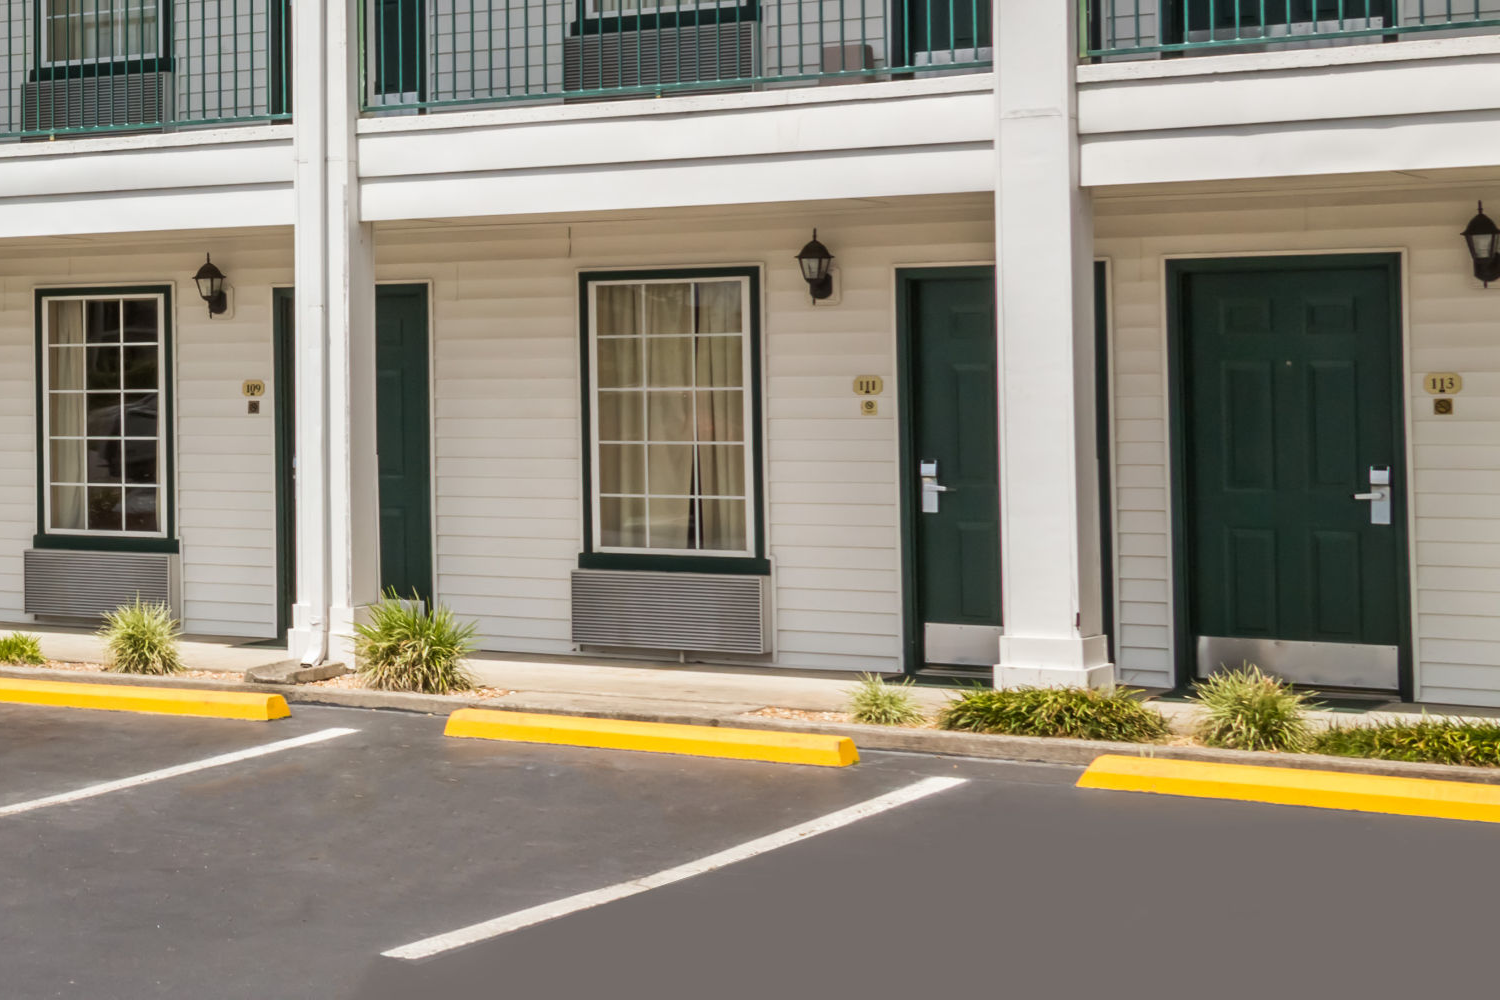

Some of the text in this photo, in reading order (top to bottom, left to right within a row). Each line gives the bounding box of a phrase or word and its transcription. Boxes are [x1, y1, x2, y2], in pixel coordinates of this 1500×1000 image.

[246, 383, 261, 396] 109
[859, 380, 876, 394] 111
[1431, 377, 1455, 393] 113
